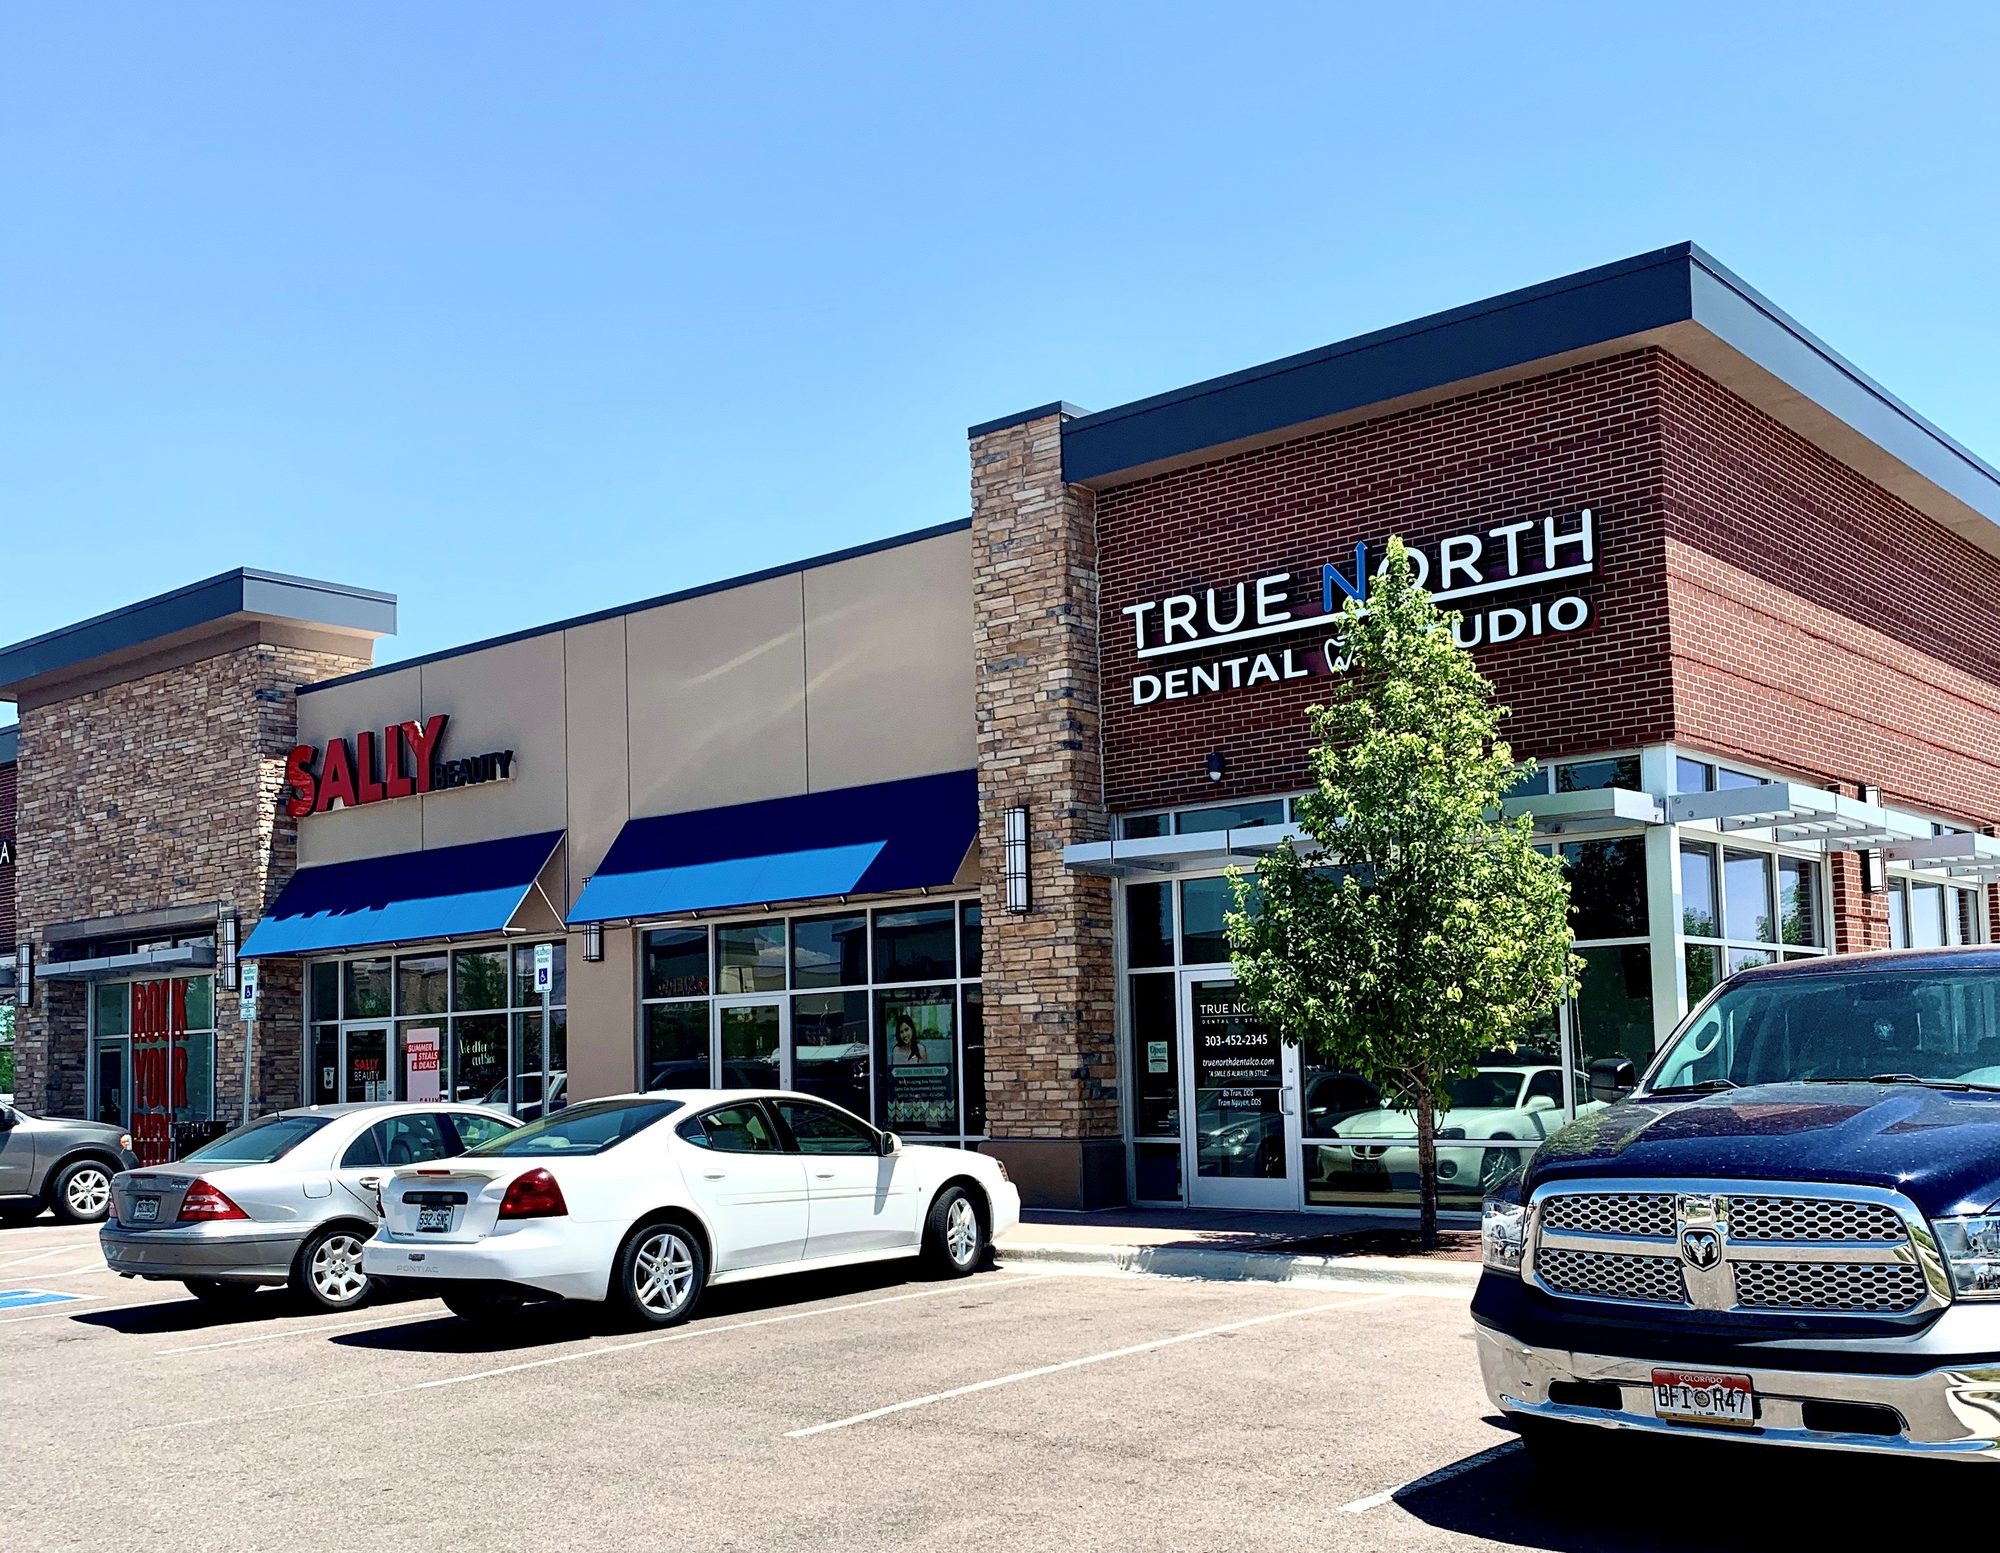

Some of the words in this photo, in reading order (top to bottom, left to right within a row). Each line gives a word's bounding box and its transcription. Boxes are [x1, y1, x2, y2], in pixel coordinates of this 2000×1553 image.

[1122, 572, 1291, 650] TRUE
[1322, 508, 1594, 613] NORTH
[1132, 648, 1308, 705] DENTAL
[1429, 596, 1589, 649] UDIO
[286, 714, 450, 818] SALLY
[434, 750, 514, 791] BEAUTY
[133, 978, 188, 1043] ROCK
[1200, 1004, 1229, 1014] TRUE
[1205, 1034, 1268, 1046] 303-452-2345
[408, 1043, 433, 1053] SUMMER
[418, 1051, 439, 1061] STEALS
[354, 1058, 380, 1070] SALLY
[418, 1060, 437, 1070] DEALS
[1203, 1057, 1275, 1067] truenorthdentalco.com
[134, 1047, 188, 1109] YOUR
[354, 1070, 380, 1081] BEAUTY
[396, 1264, 440, 1273] PONTIAC
[1679, 1374, 1723, 1383] COLORADO
